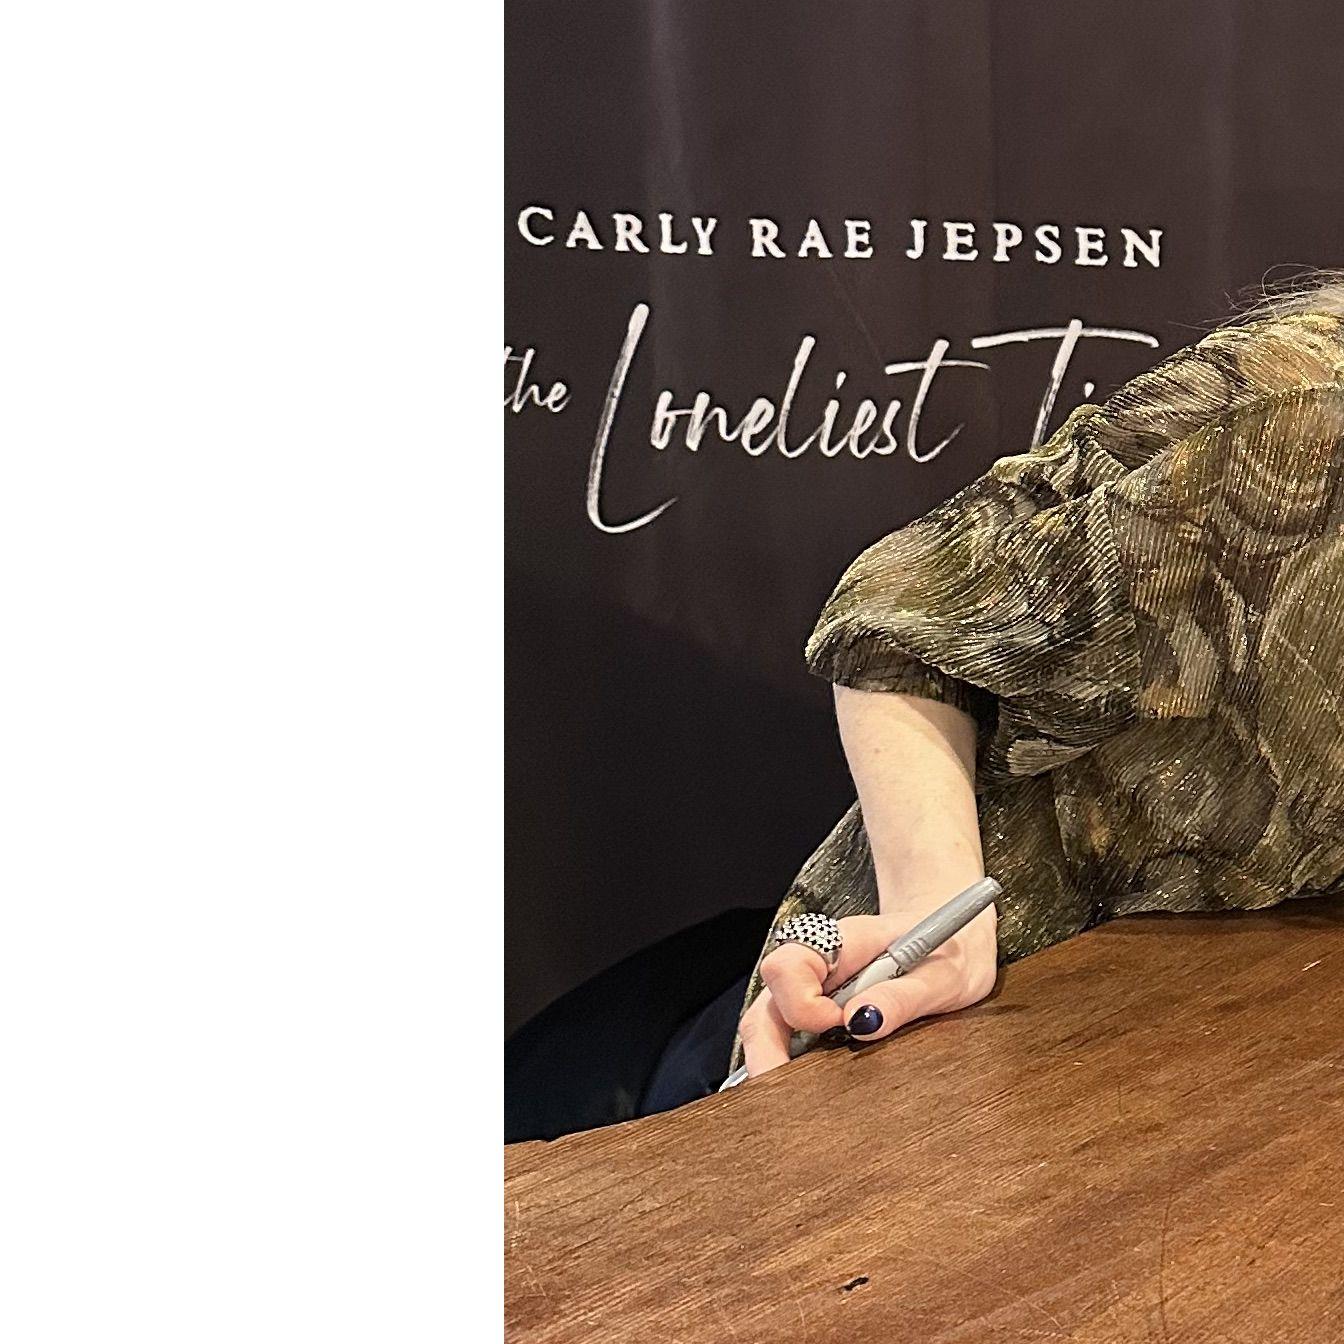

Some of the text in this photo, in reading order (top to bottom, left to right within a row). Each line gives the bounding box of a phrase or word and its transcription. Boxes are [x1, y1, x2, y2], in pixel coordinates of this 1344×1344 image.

[517, 205, 1165, 269] CARLY RAE JEPSEN
[585, 302, 990, 534] Loneliest
